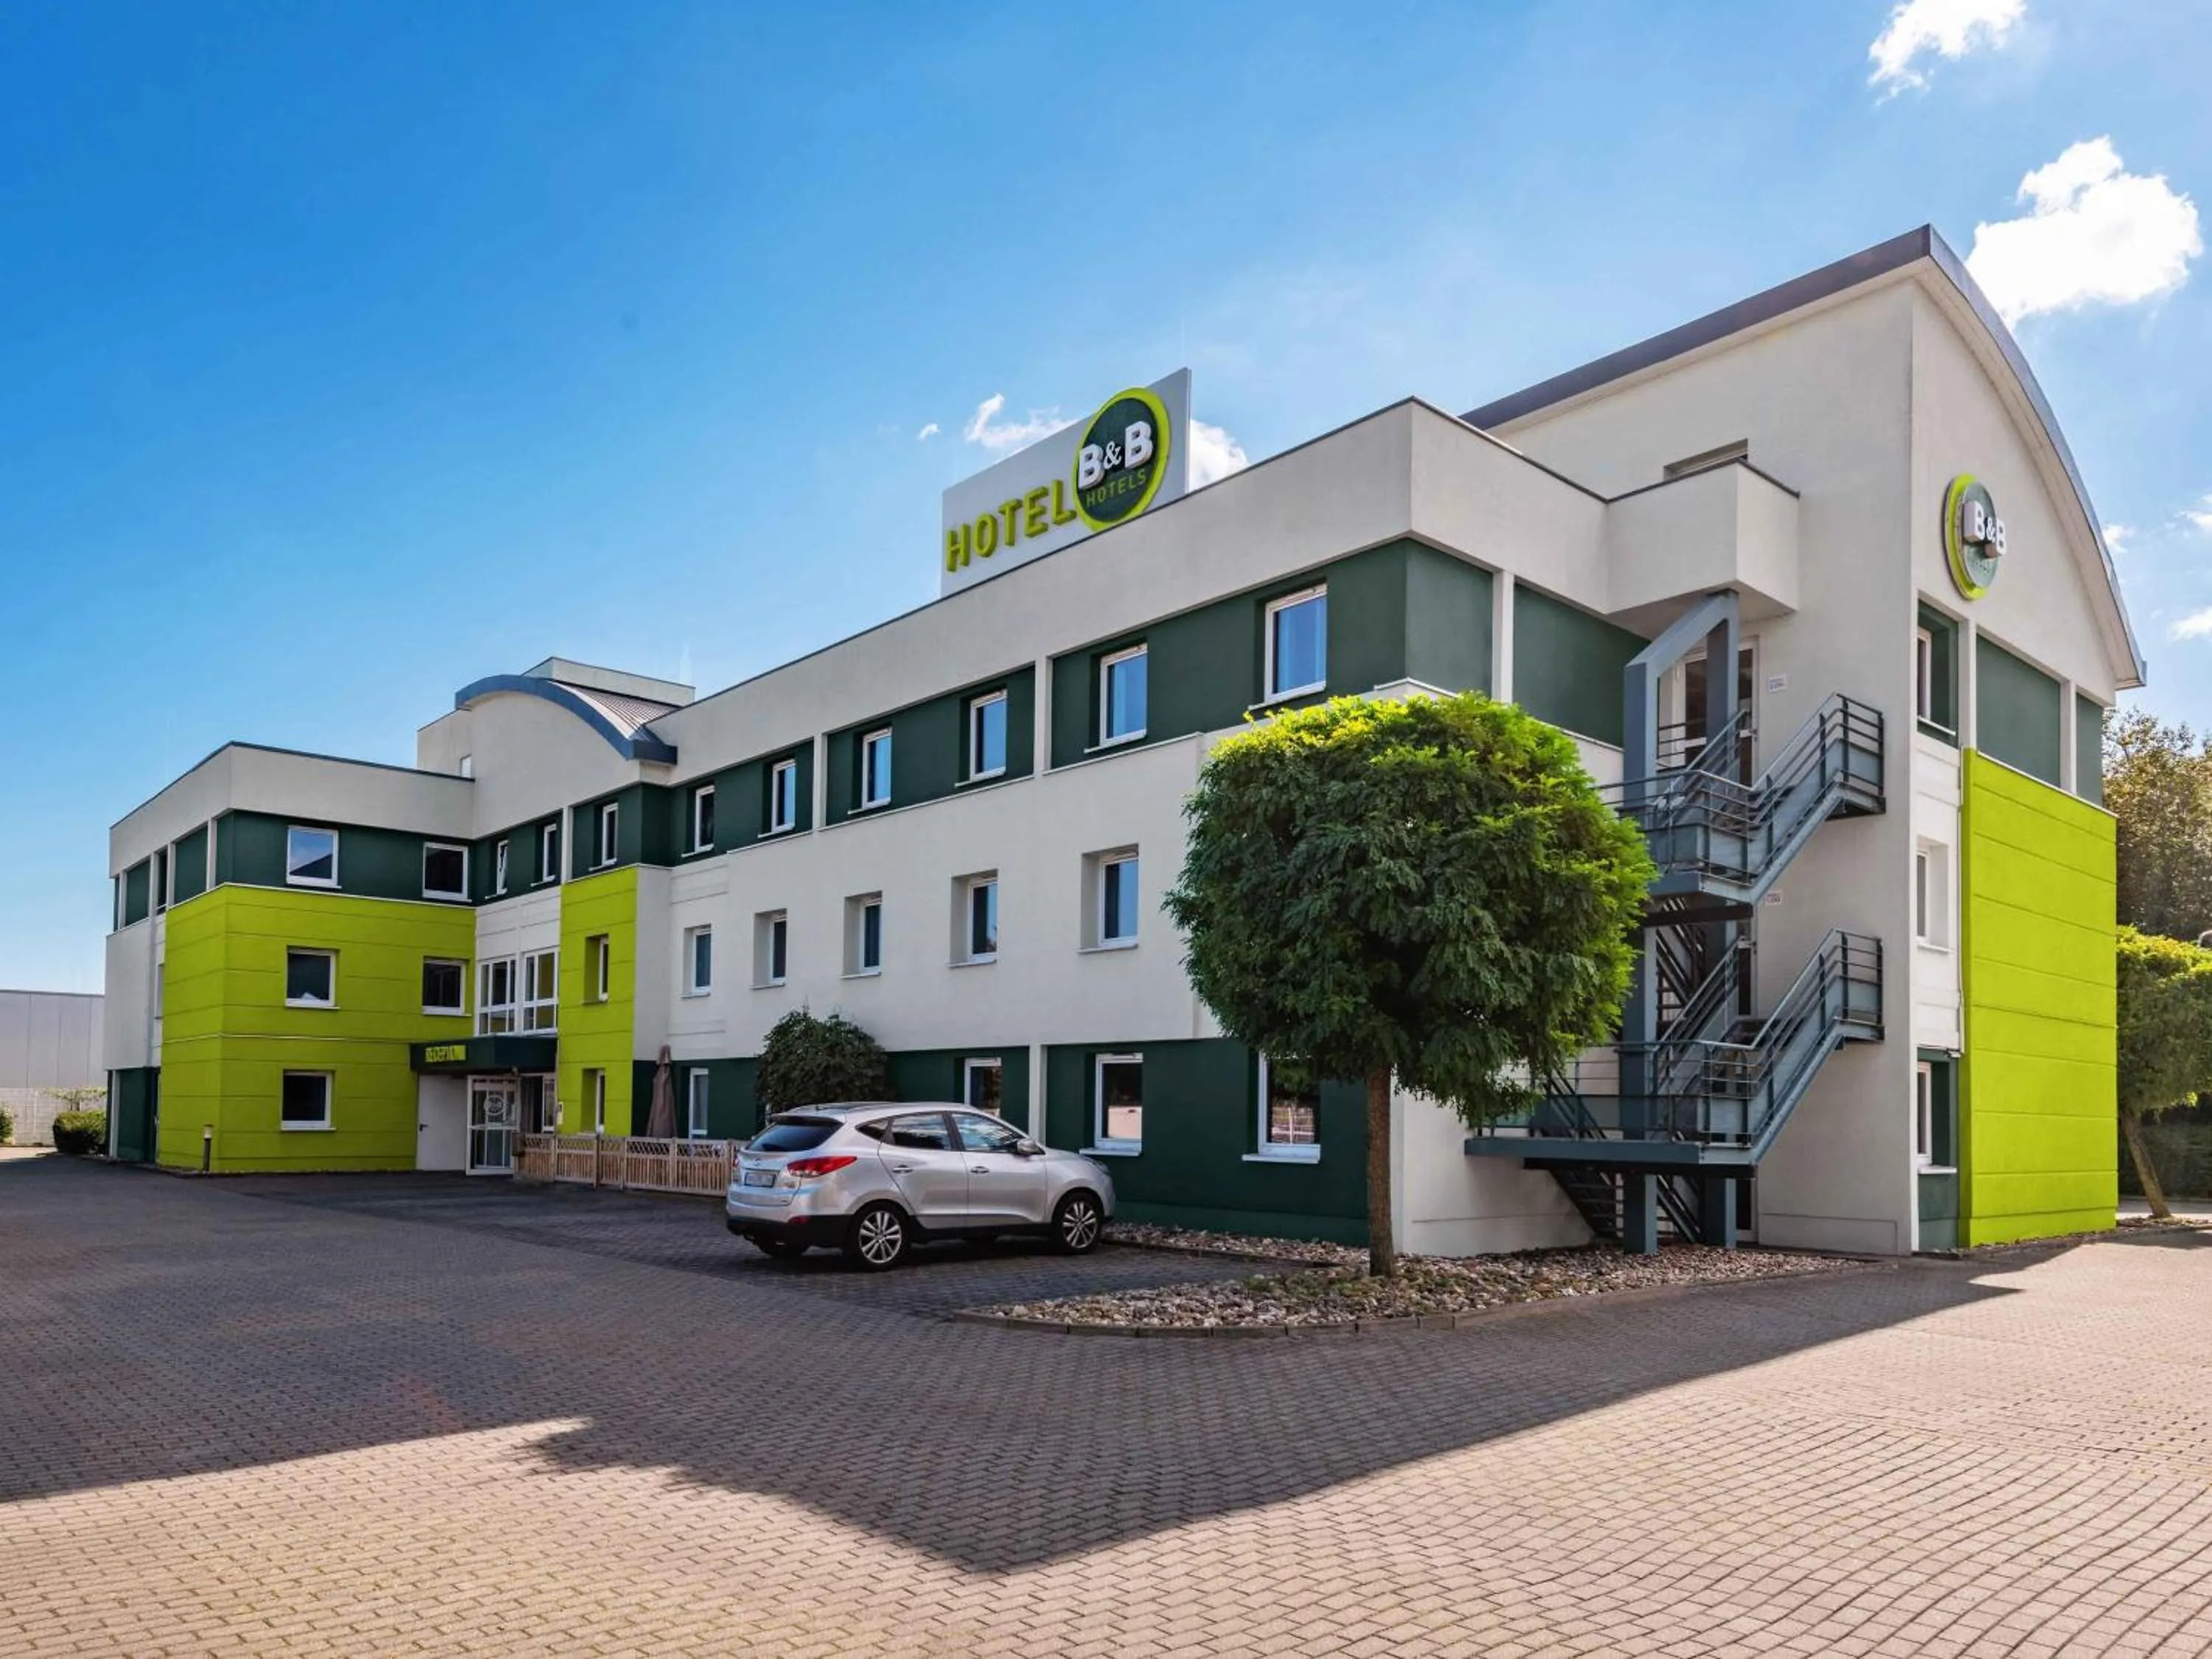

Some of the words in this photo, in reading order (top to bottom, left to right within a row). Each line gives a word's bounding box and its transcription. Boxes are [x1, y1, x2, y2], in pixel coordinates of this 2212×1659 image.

[1078, 421, 1153, 490] B&B
[1086, 469, 1147, 508] HOTELS
[945, 479, 1077, 572] HOTEL
[1964, 501, 2007, 556] B&B
